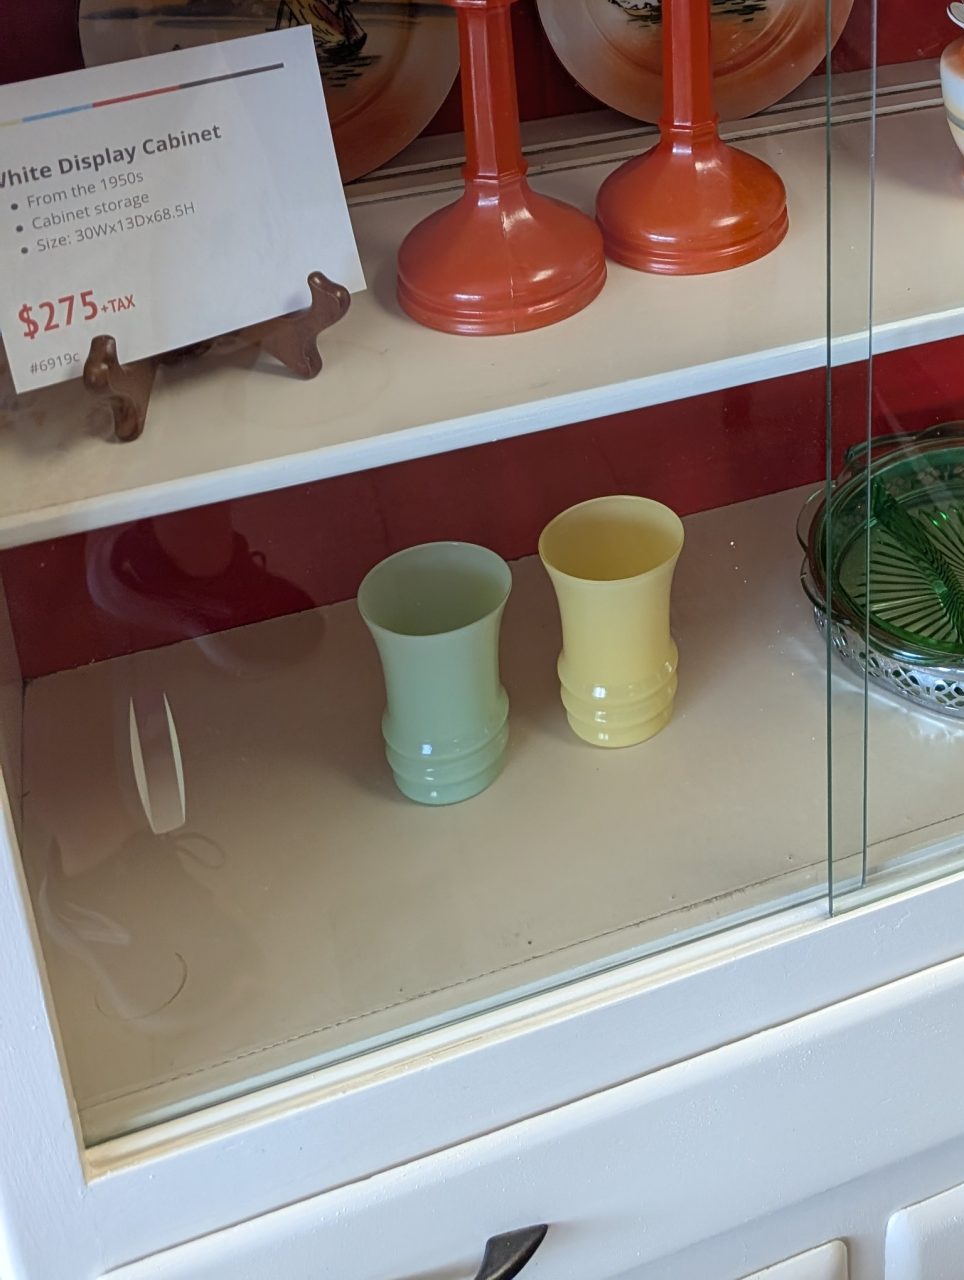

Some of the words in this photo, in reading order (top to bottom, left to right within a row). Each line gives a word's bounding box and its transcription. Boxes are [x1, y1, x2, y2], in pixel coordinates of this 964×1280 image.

[58, 144, 137, 176] Display
[142, 124, 223, 156] Cabinet
[26, 193, 68, 209] From
[71, 181, 97, 198] the
[100, 171, 145, 190] 1950s
[32, 206, 91, 231] Cabinet
[94, 192, 151, 217] storage
[36, 232, 73, 253] Size:
[75, 201, 196, 243] 30Wx13Dx68.5H
